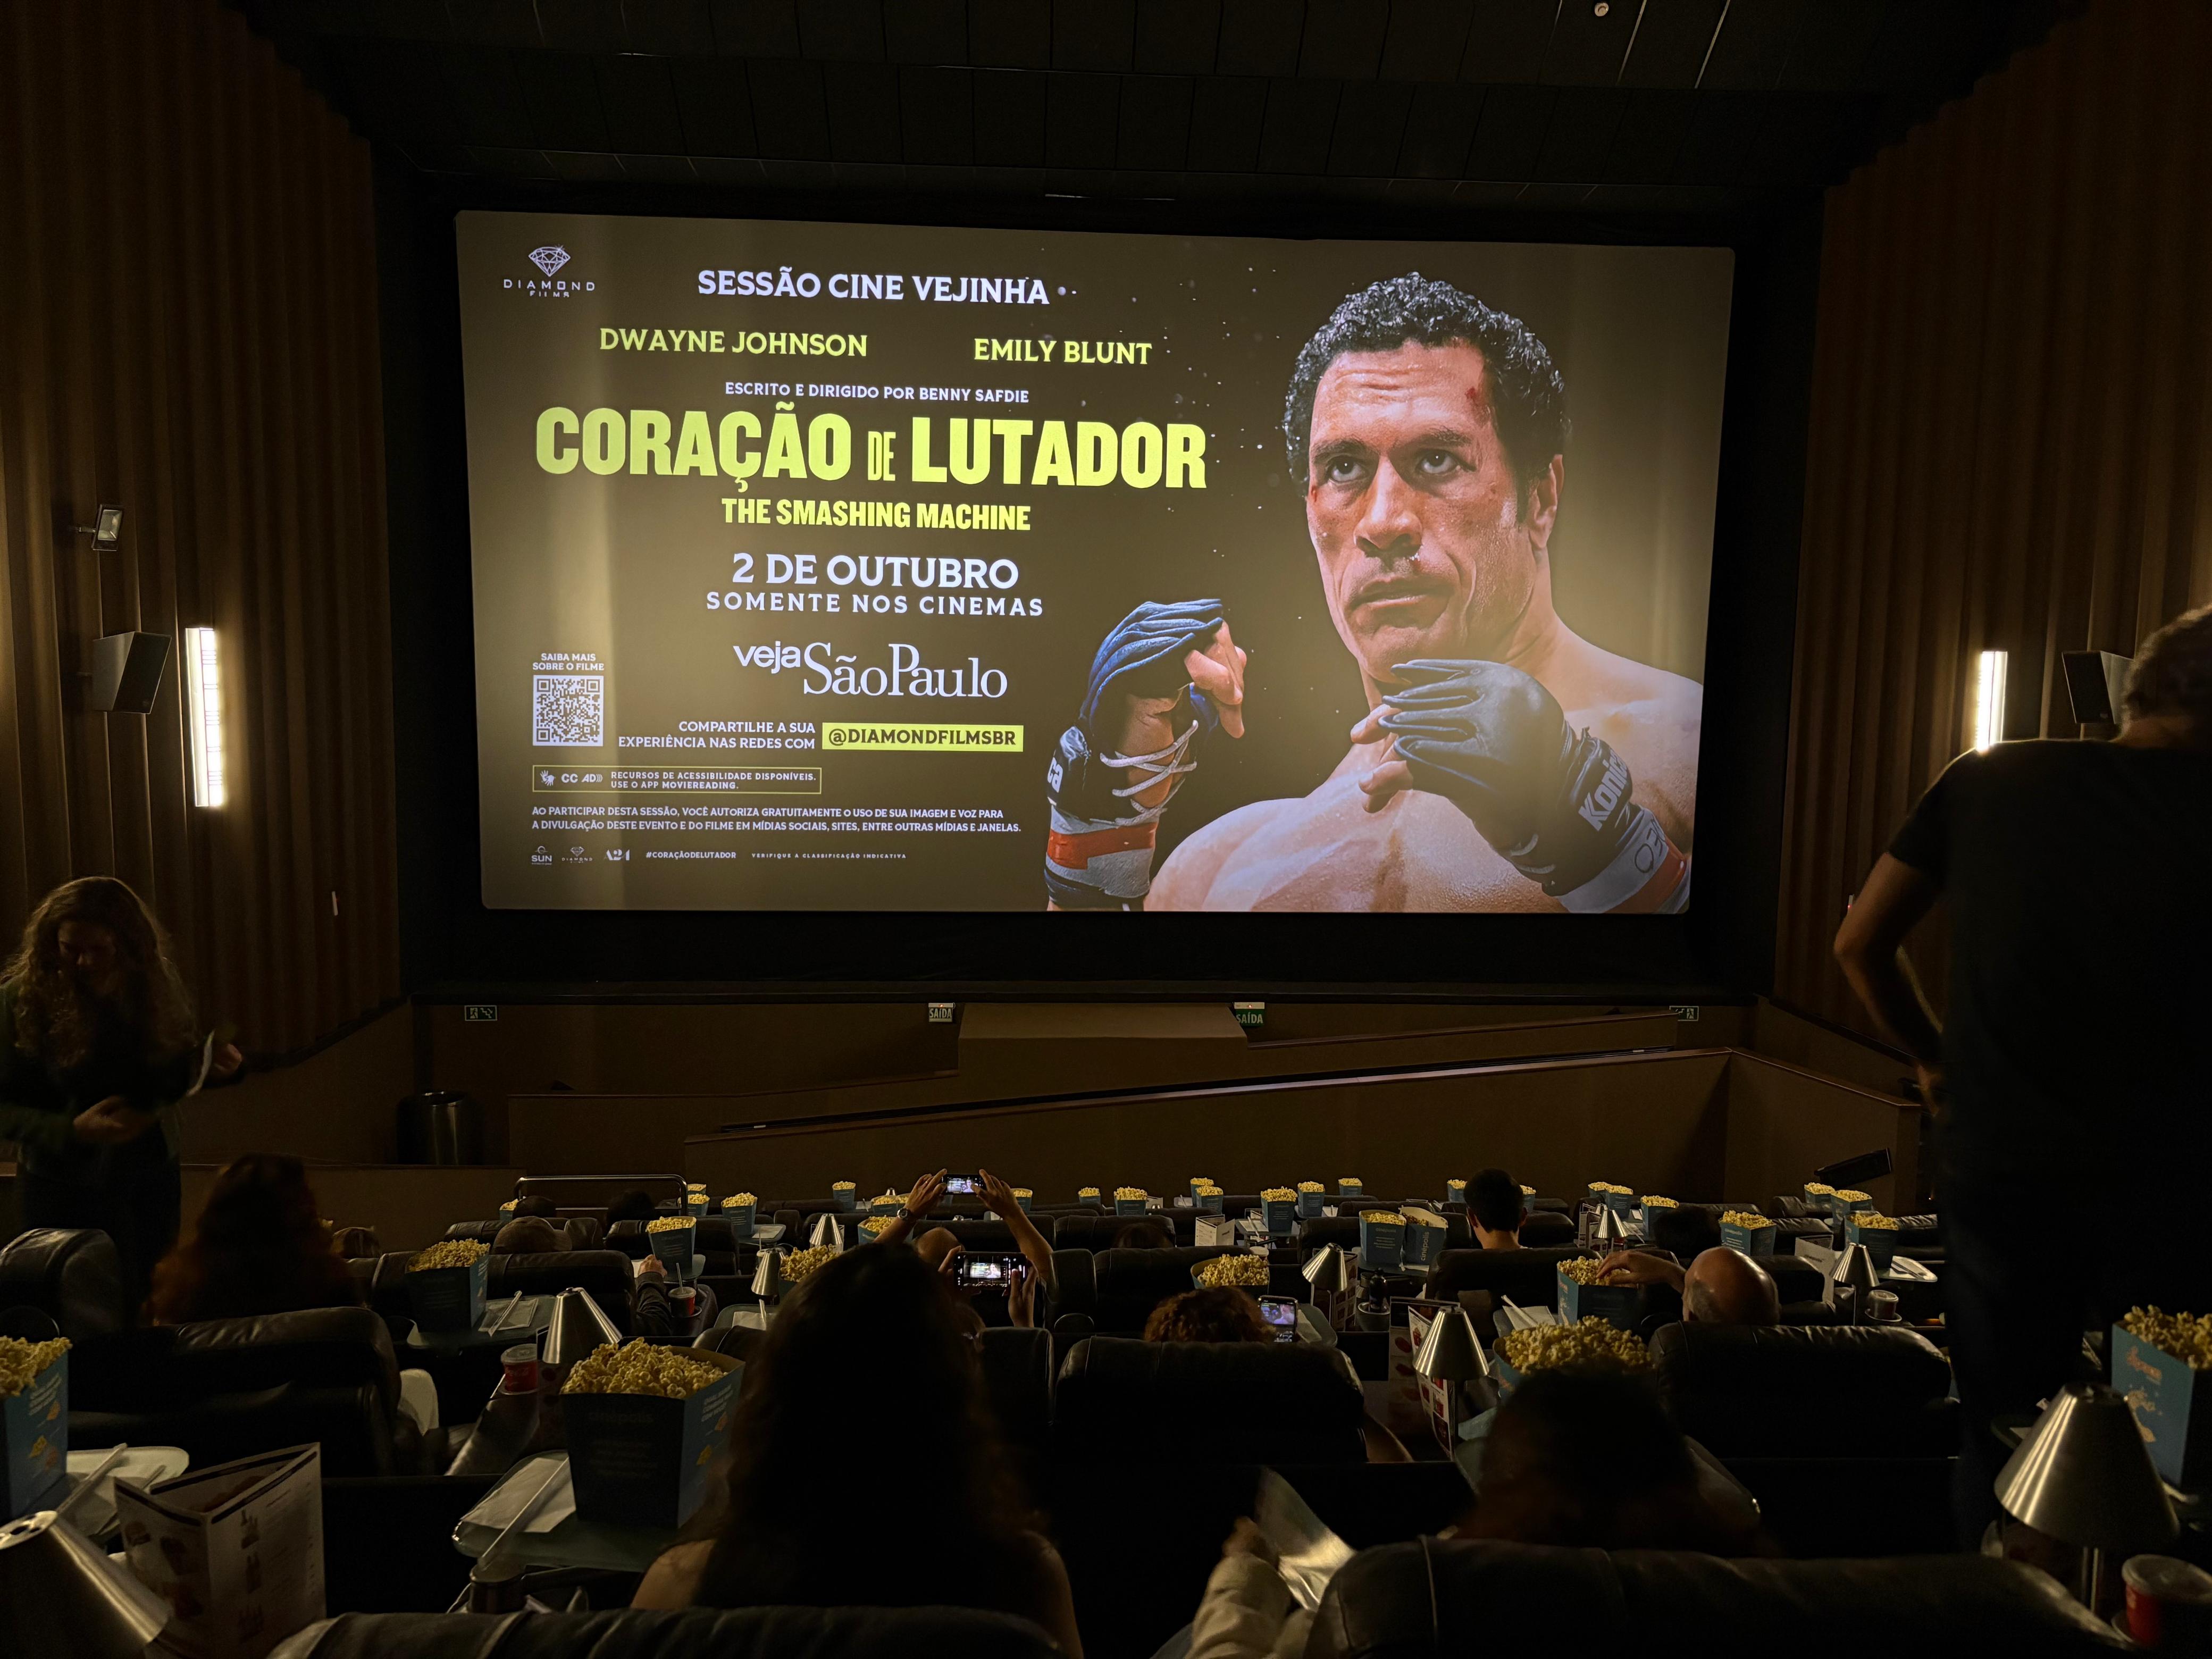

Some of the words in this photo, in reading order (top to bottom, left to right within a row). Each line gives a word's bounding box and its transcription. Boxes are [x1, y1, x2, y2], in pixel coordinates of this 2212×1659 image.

[504, 279, 595, 291] DIAMOND
[698, 266, 821, 298] SESSÃO
[828, 273, 904, 300] CINE
[911, 275, 1050, 305] VEJINHA
[600, 328, 725, 353] DWAYNE
[732, 331, 868, 357] JOHNSON
[974, 338, 1057, 362] EMILY
[1063, 341, 1152, 365] BLUNT
[725, 382, 791, 396] ESCRITO
[795, 383, 805, 396] E
[809, 384, 879, 398] DIRIGIDO
[884, 386, 915, 400] POR
[919, 387, 971, 401] BENNY
[975, 389, 1029, 403] SAFDIE
[536, 401, 851, 493] CORAÇÃO
[867, 431, 896, 481] DE
[911, 416, 1207, 489] LUTADOR
[721, 498, 771, 524] THE
[776, 499, 911, 528] SMASHING
[916, 502, 1031, 531] MACHINE
[732, 552, 754, 583] 2
[766, 554, 818, 584] DE
[826, 555, 1019, 589] OUTUBRO
[706, 591, 840, 612] SOMENTE
[852, 594, 908, 614] NOS
[919, 596, 1043, 616] CINEMAS
[541, 652, 570, 661] SAIBA
[572, 653, 596, 661] MAIS
[532, 662, 565, 671] SOBRE
[566, 662, 574, 671] O
[576, 663, 605, 671] FILME
[678, 721, 774, 733] COMPARTILHE
[776, 722, 787, 733] A
[789, 722, 816, 733] SUA
[618, 734, 707, 748] EXPERIÊNCIA
[709, 737, 736, 748] NAS
[740, 738, 782, 749] REDES
[784, 738, 815, 749] COM
[828, 728, 1016, 747] @DIAMONDFILMSBR
[561, 773, 579, 783] CC
[677, 772, 752, 780] ACESSIBILIDADE
[755, 772, 816, 781] DISPONÍVEIS.
[662, 781, 739, 790] MOVIEREADING.
[532, 806, 547, 815] AO
[548, 806, 606, 816] PARTICIPAR
[607, 807, 639, 816] DESTA
[640, 806, 680, 817] SESSÃO,
[682, 806, 709, 816] VOCÊ
[710, 807, 760, 816] AUTORIZA
[761, 808, 842, 817] GRATUITAMENTE
[843, 809, 851, 817] O
[853, 808, 873, 817] USO
[875, 808, 887, 817] DE
[889, 809, 908, 818] SUA
[910, 809, 948, 818] IMAGEM
[950, 809, 957, 818] E
[958, 809, 977, 818] VOZ
[978, 809, 1004, 818] PARA
[532, 820, 539, 830] A
[541, 819, 605, 832] DIVULGAÇÃO
[607, 820, 638, 830] DESTE
[639, 820, 678, 830] EVENTO
[680, 821, 686, 830] E
[688, 821, 703, 830] DO
[705, 821, 734, 830] FILME
[736, 821, 750, 830] EM
[752, 820, 787, 831] MÍDIAS
[789, 822, 830, 832] SOCIAIS,
[831, 822, 860, 832] SITES,
[862, 822, 893, 831] ENTRE
[894, 822, 934, 832] OUTRAS
[935, 821, 969, 832] MÍDIAS
[970, 823, 976, 832] E
[977, 823, 1021, 832] JANELAS.
[646, 850, 736, 860] #CORAÇÃODELUTADOR
[928, 1008, 952, 1018] SAÍDA
[1235, 1012, 1264, 1024] SAÍDA
